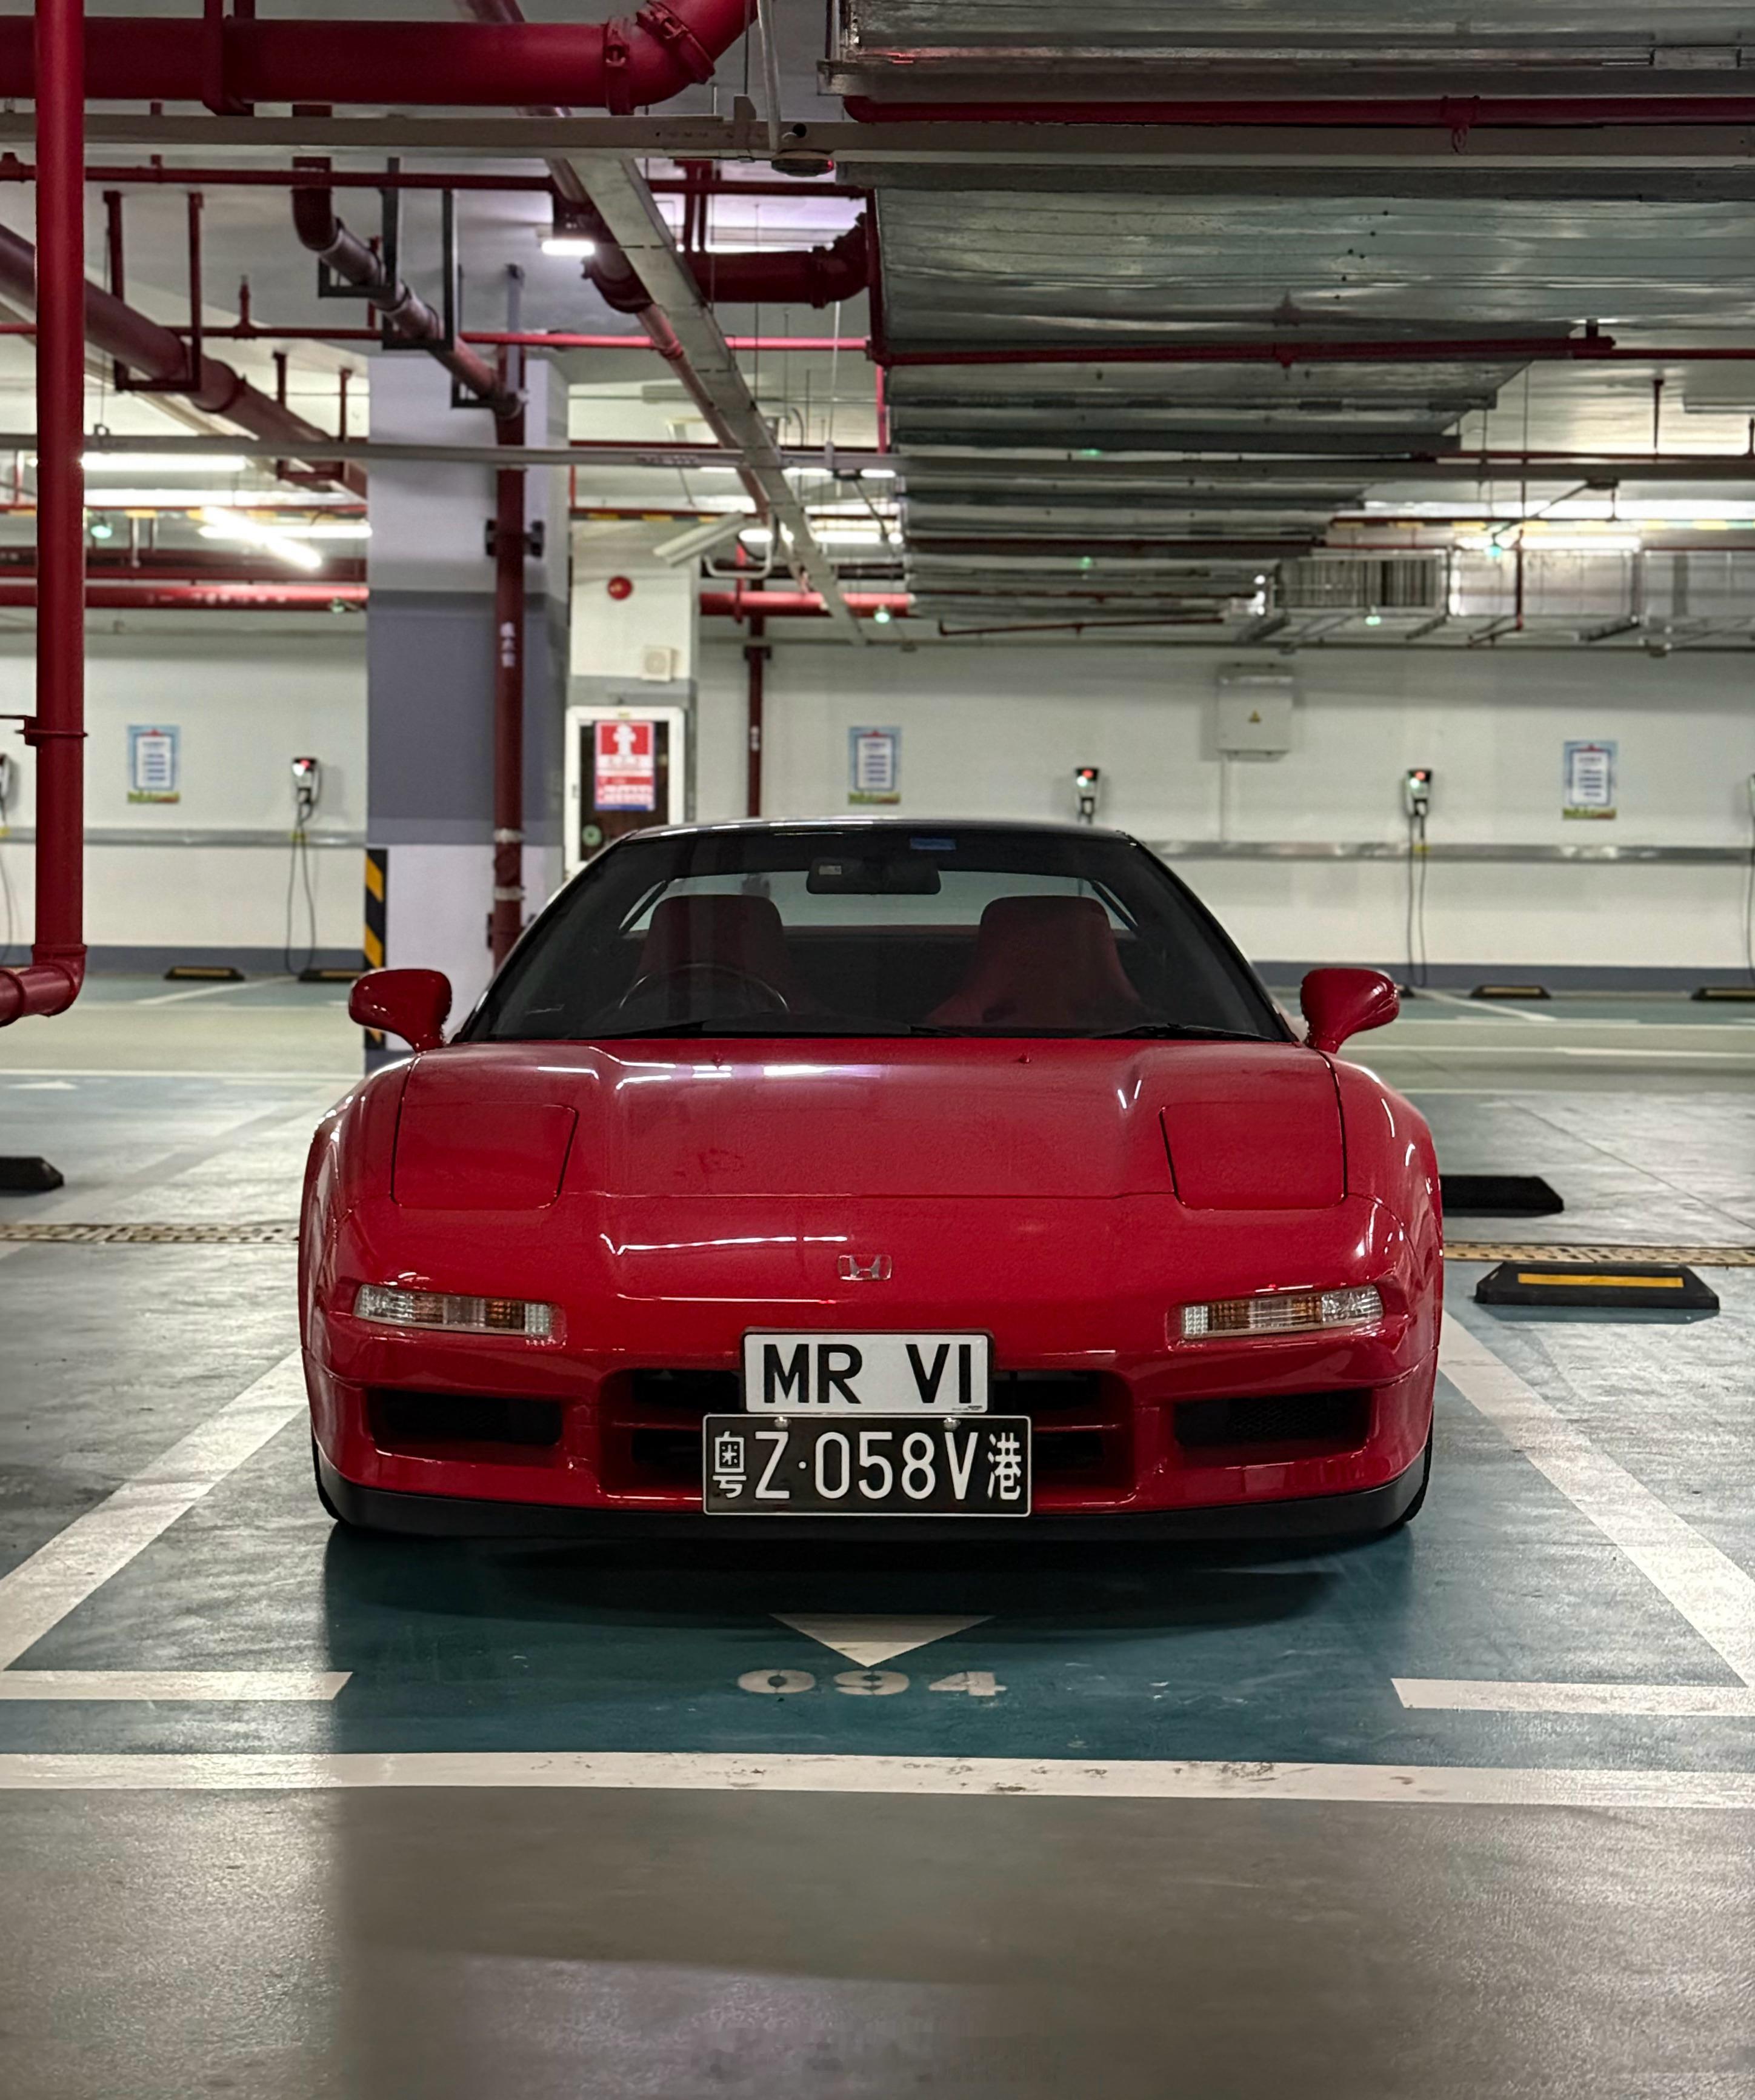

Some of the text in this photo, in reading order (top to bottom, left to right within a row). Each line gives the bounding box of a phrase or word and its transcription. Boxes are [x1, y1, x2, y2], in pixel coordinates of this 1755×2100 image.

[763, 1343, 971, 1404] MR VI
[737, 1669, 1007, 1696] 094
